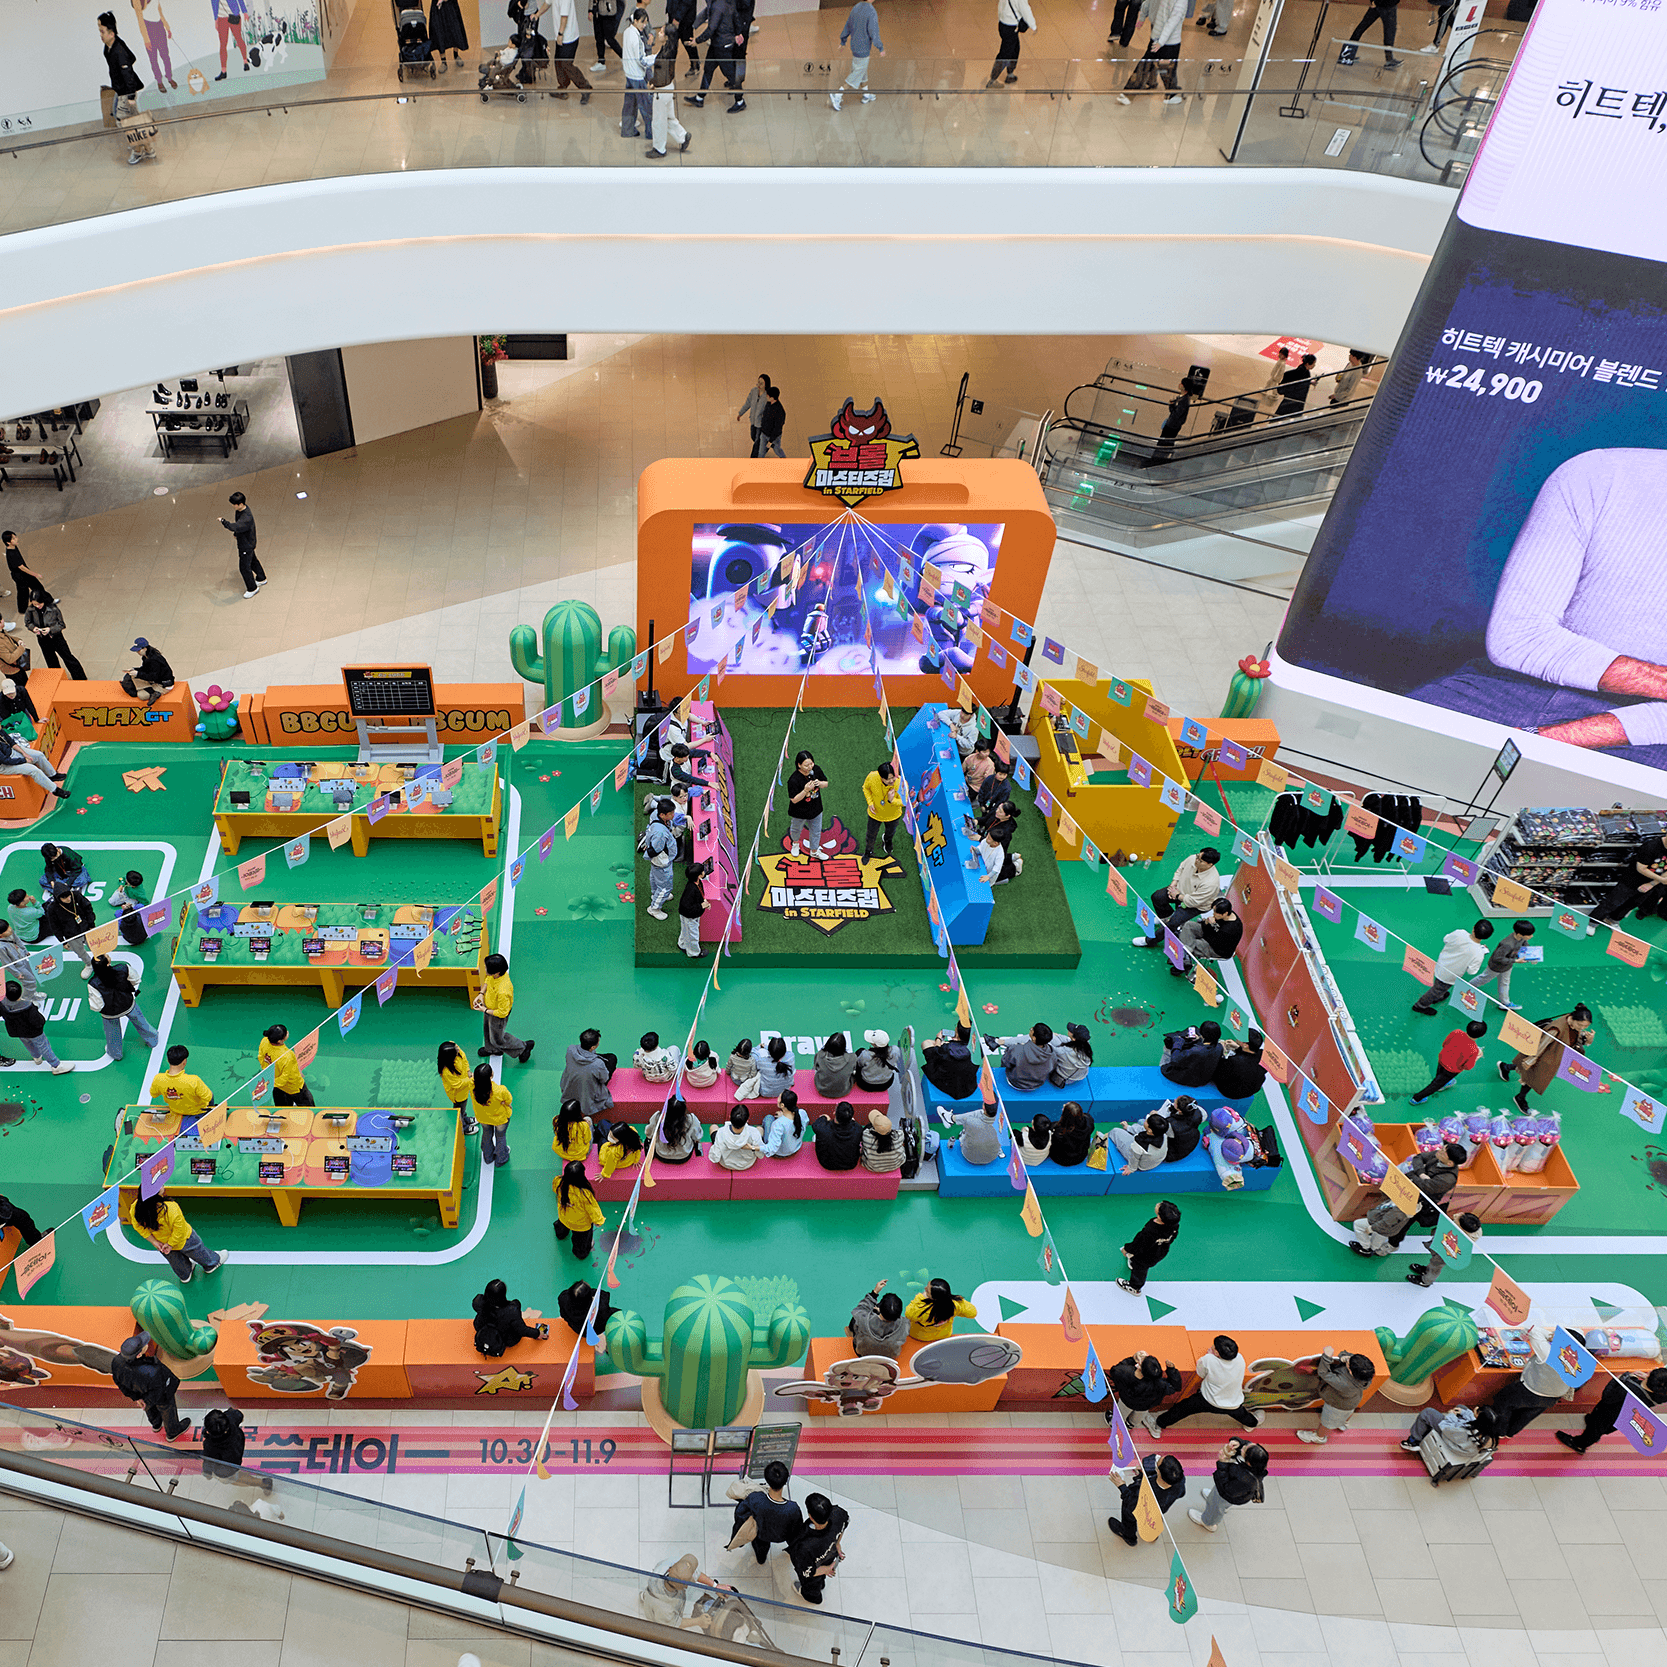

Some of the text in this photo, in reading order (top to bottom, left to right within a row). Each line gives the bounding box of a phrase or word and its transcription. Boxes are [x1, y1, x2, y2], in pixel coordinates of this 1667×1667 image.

[126, 128, 148, 144] NIKE
[1441, 327, 1663, 390] 히트텍 캐시미어 블렌드
[1425, 364, 1543, 404] ₩24,900
[823, 443, 887, 470] 브롤
[815, 469, 895, 487] 마스터즈컵
[823, 487, 832, 495] in
[777, 857, 863, 888] 브롤
[770, 886, 880, 908] 마스터즈컵
[784, 908, 798, 917] in
[260, 1434, 617, 1473] 쓱데이 10.30-11.9
